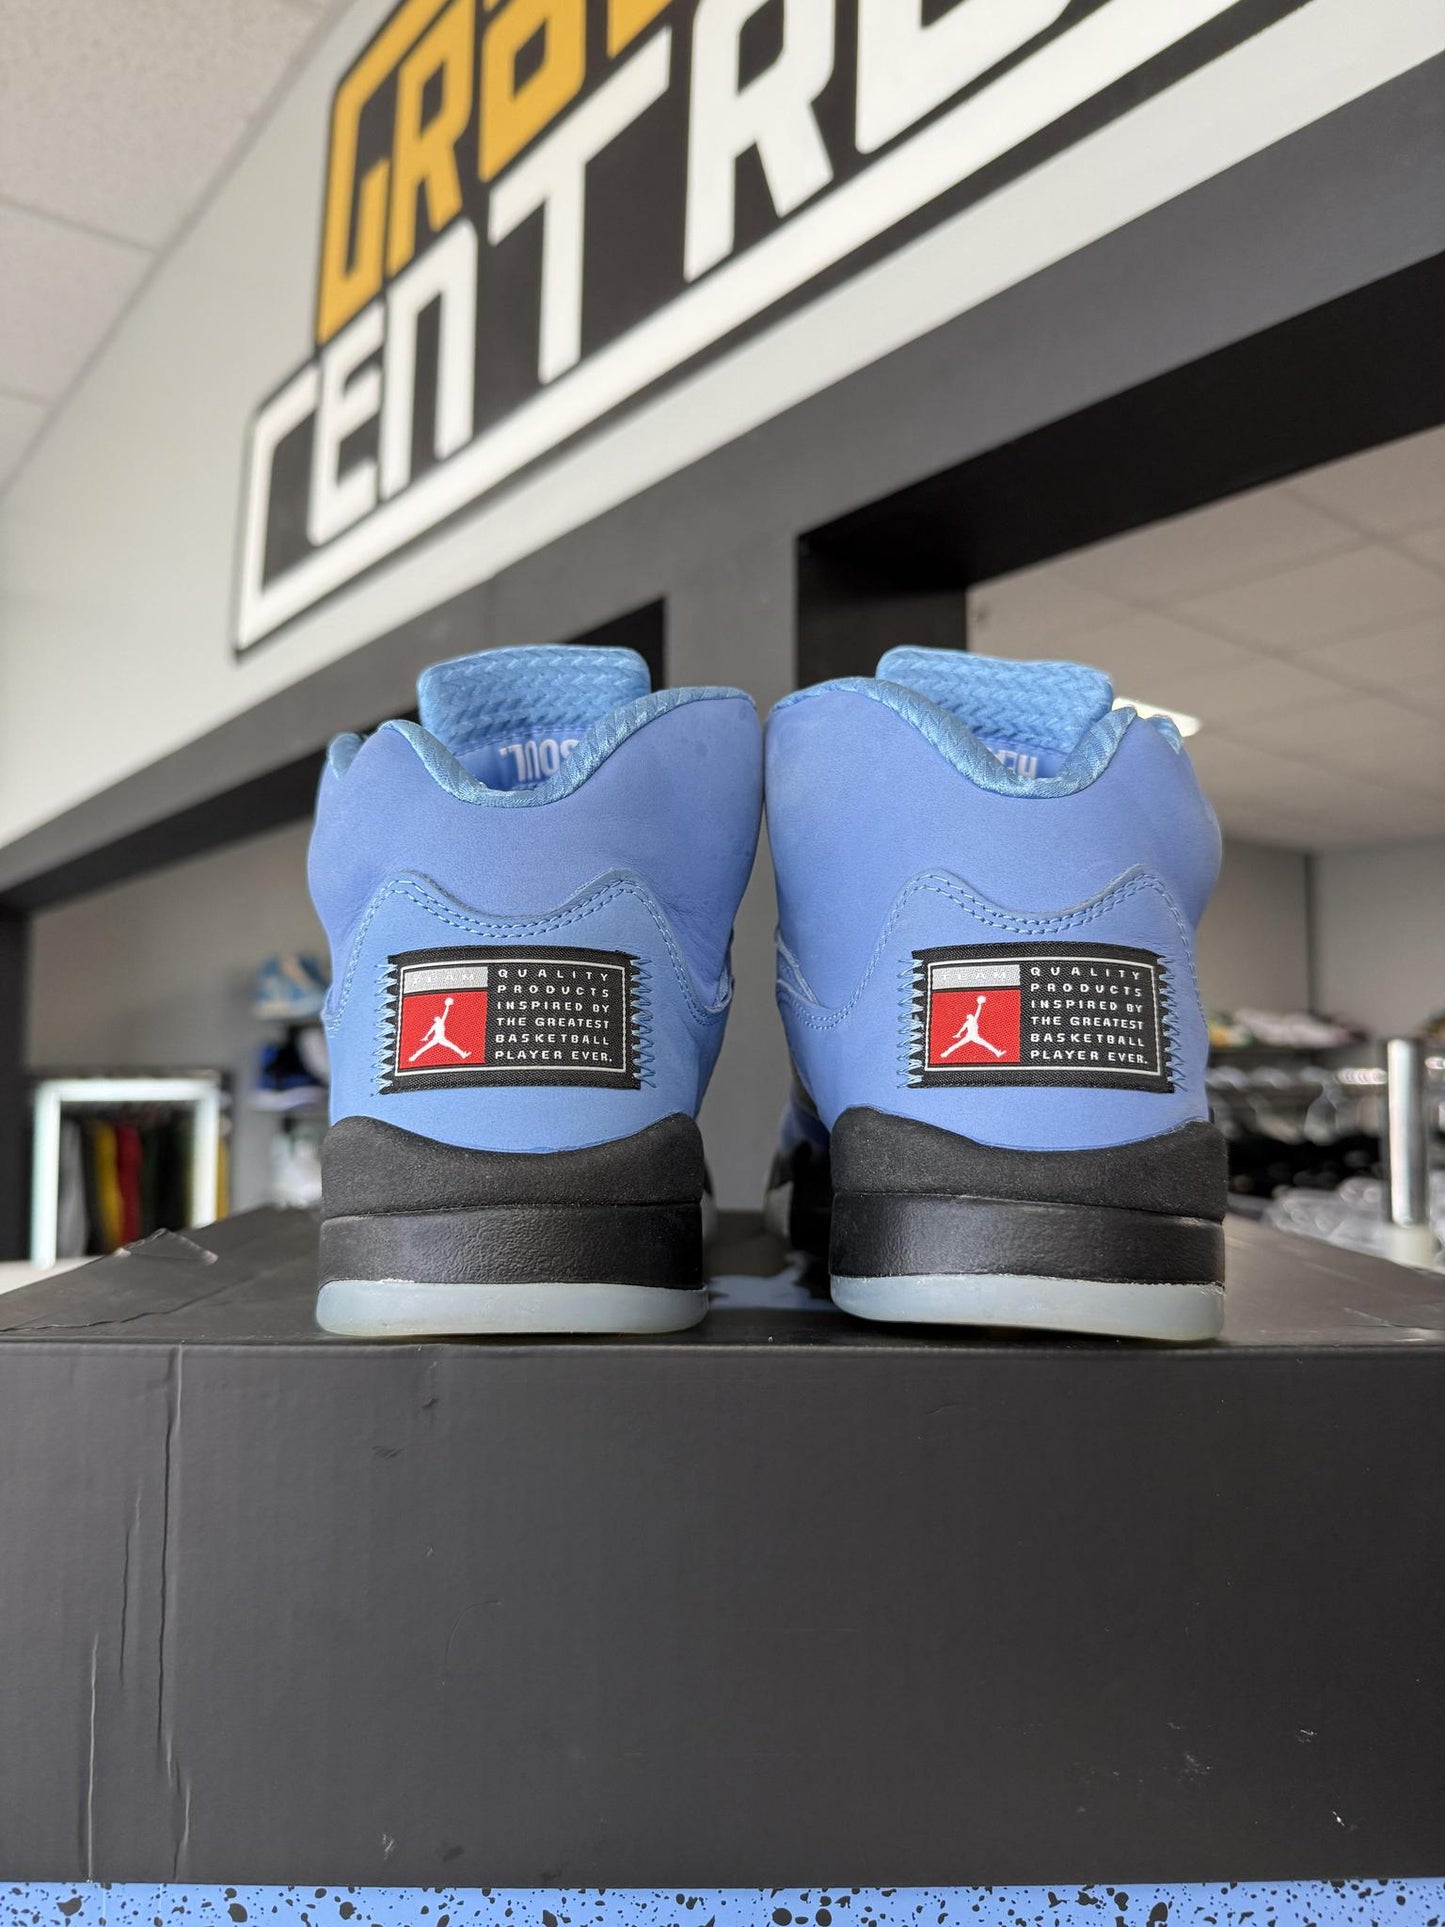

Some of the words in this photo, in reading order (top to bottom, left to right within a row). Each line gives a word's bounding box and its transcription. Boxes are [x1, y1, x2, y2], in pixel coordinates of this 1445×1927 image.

[498, 968, 608, 982] QUALITY
[1030, 966, 1140, 980] QUALITY
[497, 984, 609, 998] PRODUCTS
[1030, 983, 1142, 997] PRODUCTS
[497, 1001, 583, 1011] INSPIRED
[592, 1003, 610, 1013] BY
[1030, 1000, 1118, 1011] INSPIRED
[1126, 1003, 1143, 1013] BY
[496, 1017, 527, 1026] THE
[534, 1017, 610, 1029] GREATEST
[1030, 1016, 1062, 1026] THE
[1069, 1016, 1144, 1030] GREATEST
[495, 1033, 609, 1046] BASKETBALL
[1030, 1033, 1145, 1047] BASKETBALL
[494, 1050, 562, 1060] PLAYER
[571, 1050, 613, 1062] EVER.
[1030, 1049, 1099, 1061] PLAYER
[1107, 1051, 1148, 1064] EVER.
